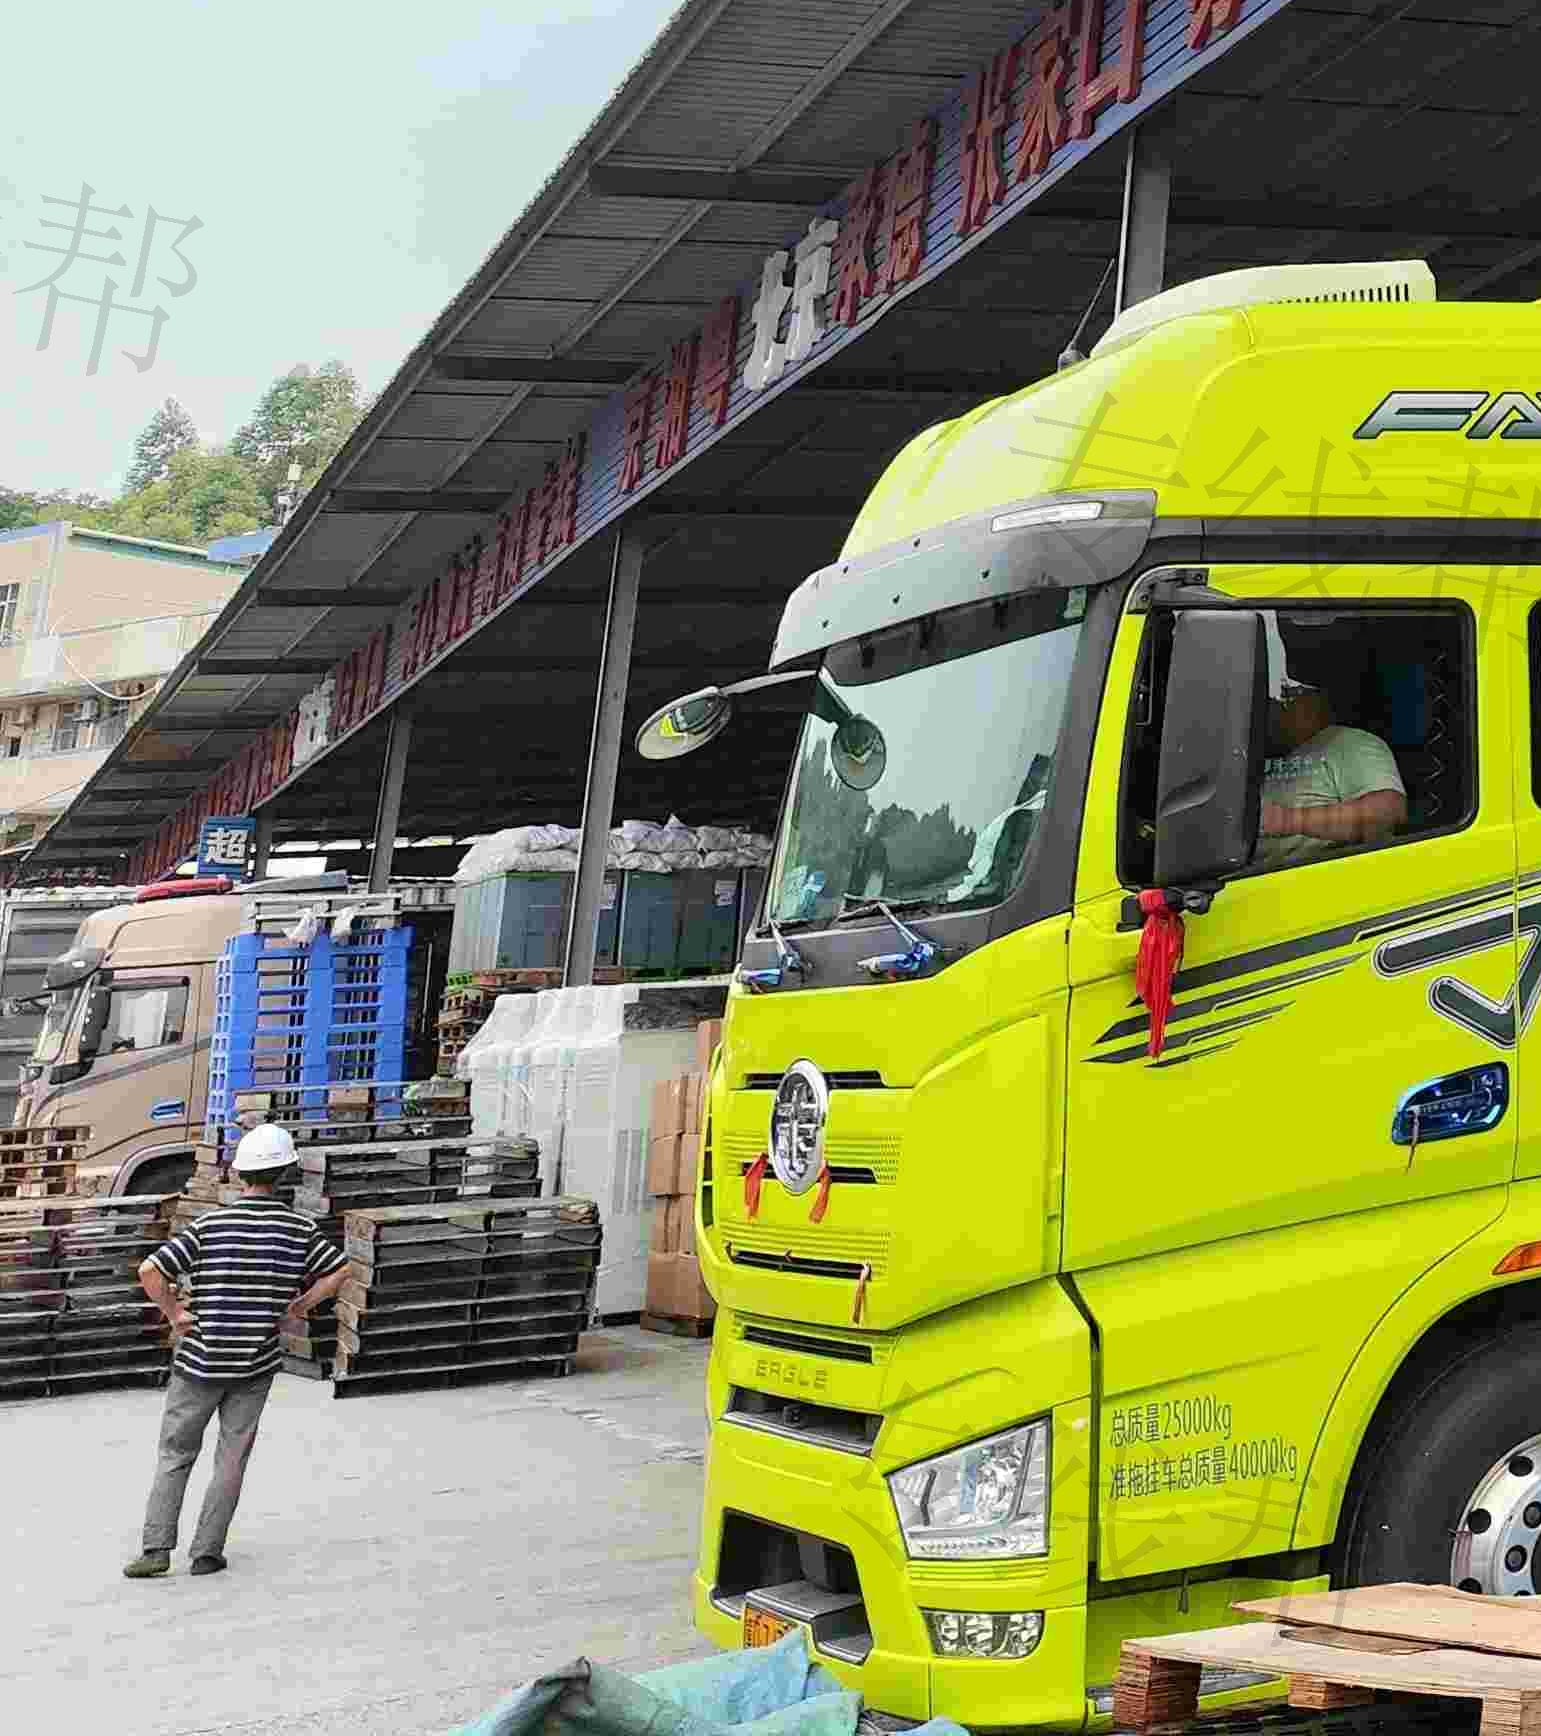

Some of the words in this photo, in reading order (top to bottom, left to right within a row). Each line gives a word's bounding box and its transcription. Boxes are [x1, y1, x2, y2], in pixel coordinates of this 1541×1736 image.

[206, 827, 249, 864] 超
[1110, 1393, 1233, 1448] 总质量25000kg
[1109, 1437, 1298, 1502] 准拖挂车总质量40000kg
